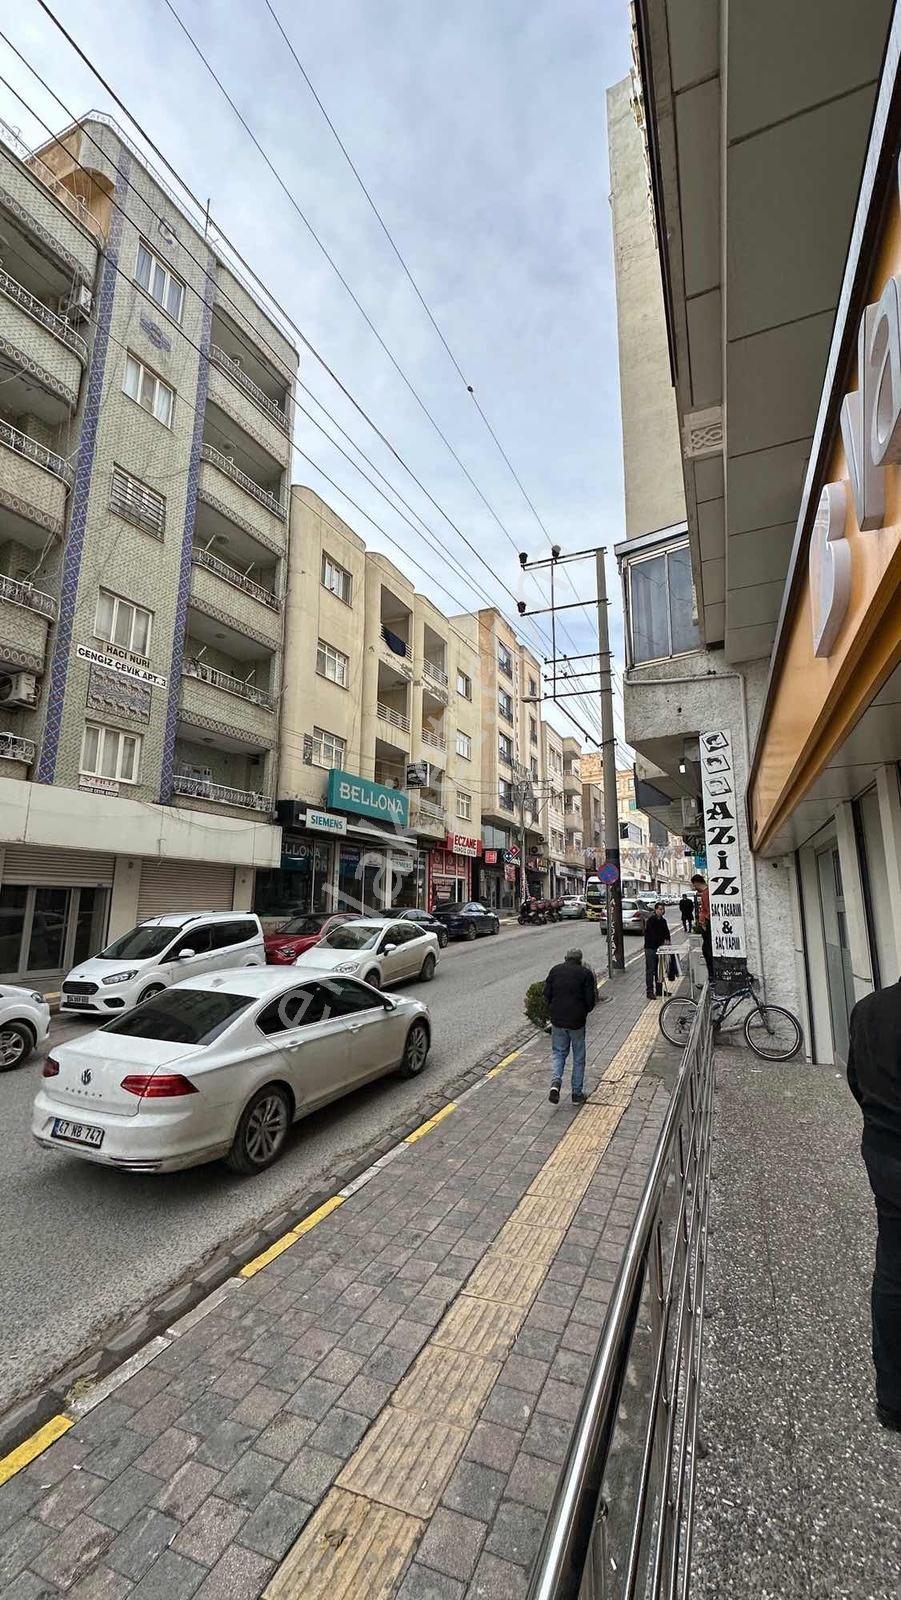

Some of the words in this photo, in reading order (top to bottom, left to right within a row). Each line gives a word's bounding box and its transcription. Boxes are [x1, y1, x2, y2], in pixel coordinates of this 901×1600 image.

[339, 781, 404, 815] BELLONA
[310, 814, 343, 830] SIEMENS
[454, 835, 476, 850] ECZANE
[722, 920, 733, 934] &
[59, 1121, 70, 1135] 47
[84, 1127, 102, 1142] 747
